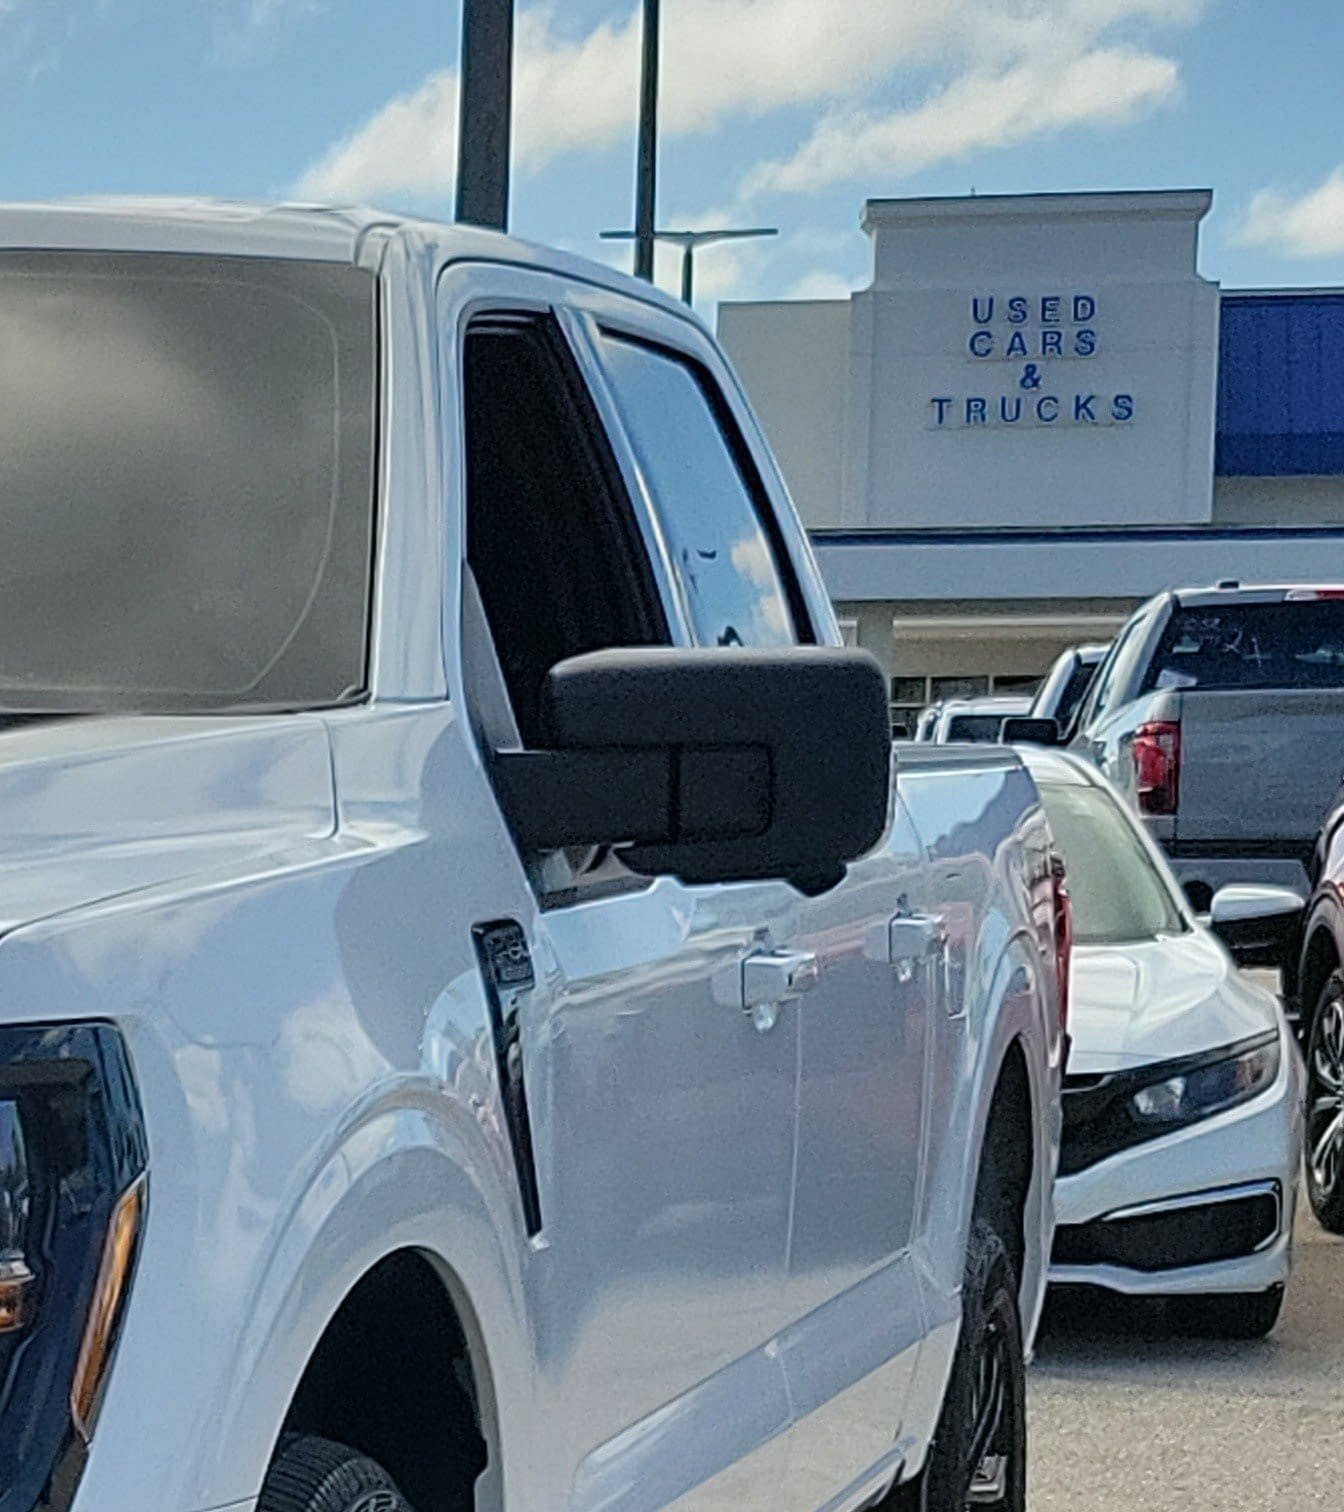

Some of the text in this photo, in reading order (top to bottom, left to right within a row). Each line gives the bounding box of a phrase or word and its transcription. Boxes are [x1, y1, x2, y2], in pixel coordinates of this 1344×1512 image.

[972, 295, 1096, 324] USED
[969, 329, 1097, 358] CARS
[1019, 363, 1042, 390] &
[930, 394, 1134, 425] TRUCKS
